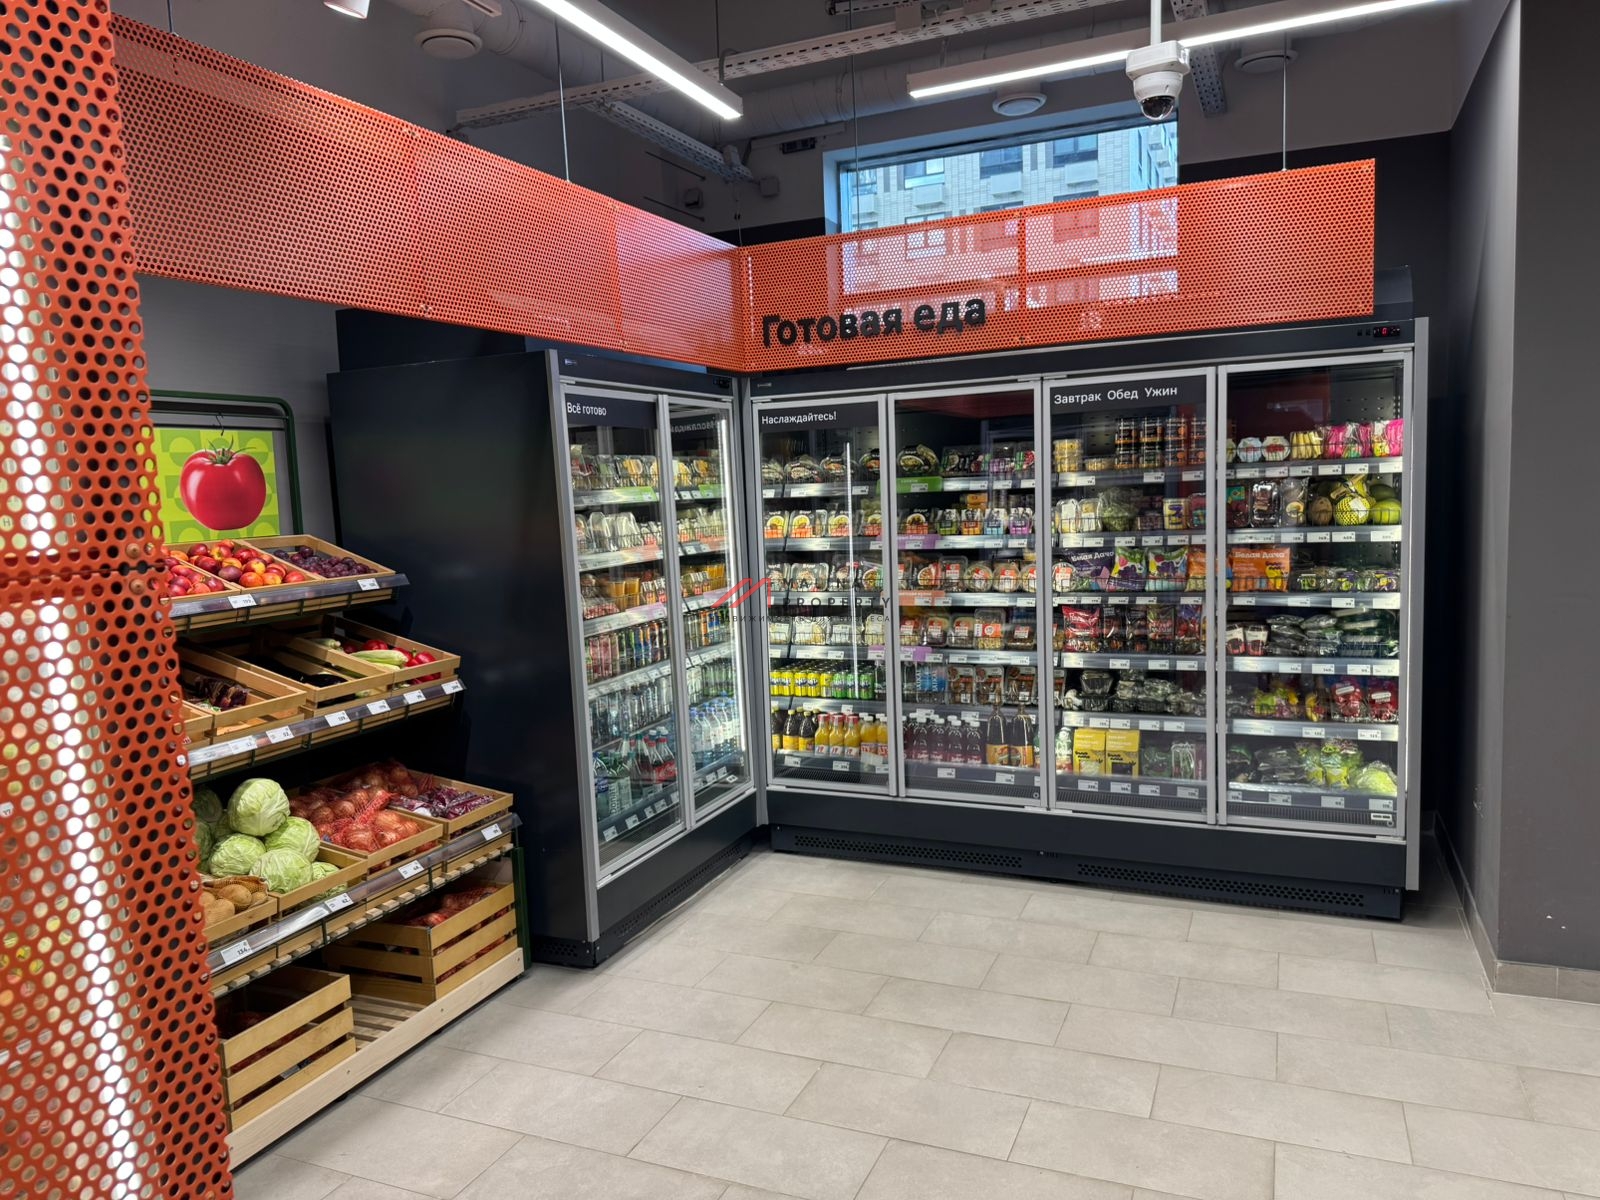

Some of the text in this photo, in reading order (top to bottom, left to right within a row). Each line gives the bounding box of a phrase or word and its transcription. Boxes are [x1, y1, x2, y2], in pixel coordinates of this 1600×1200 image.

[762, 298, 986, 348] Готовая еда
[1054, 386, 1178, 405] Завтрак Обед Ужин
[567, 402, 607, 416] Всё готово
[761, 411, 837, 425] Наслаждайтесь!
